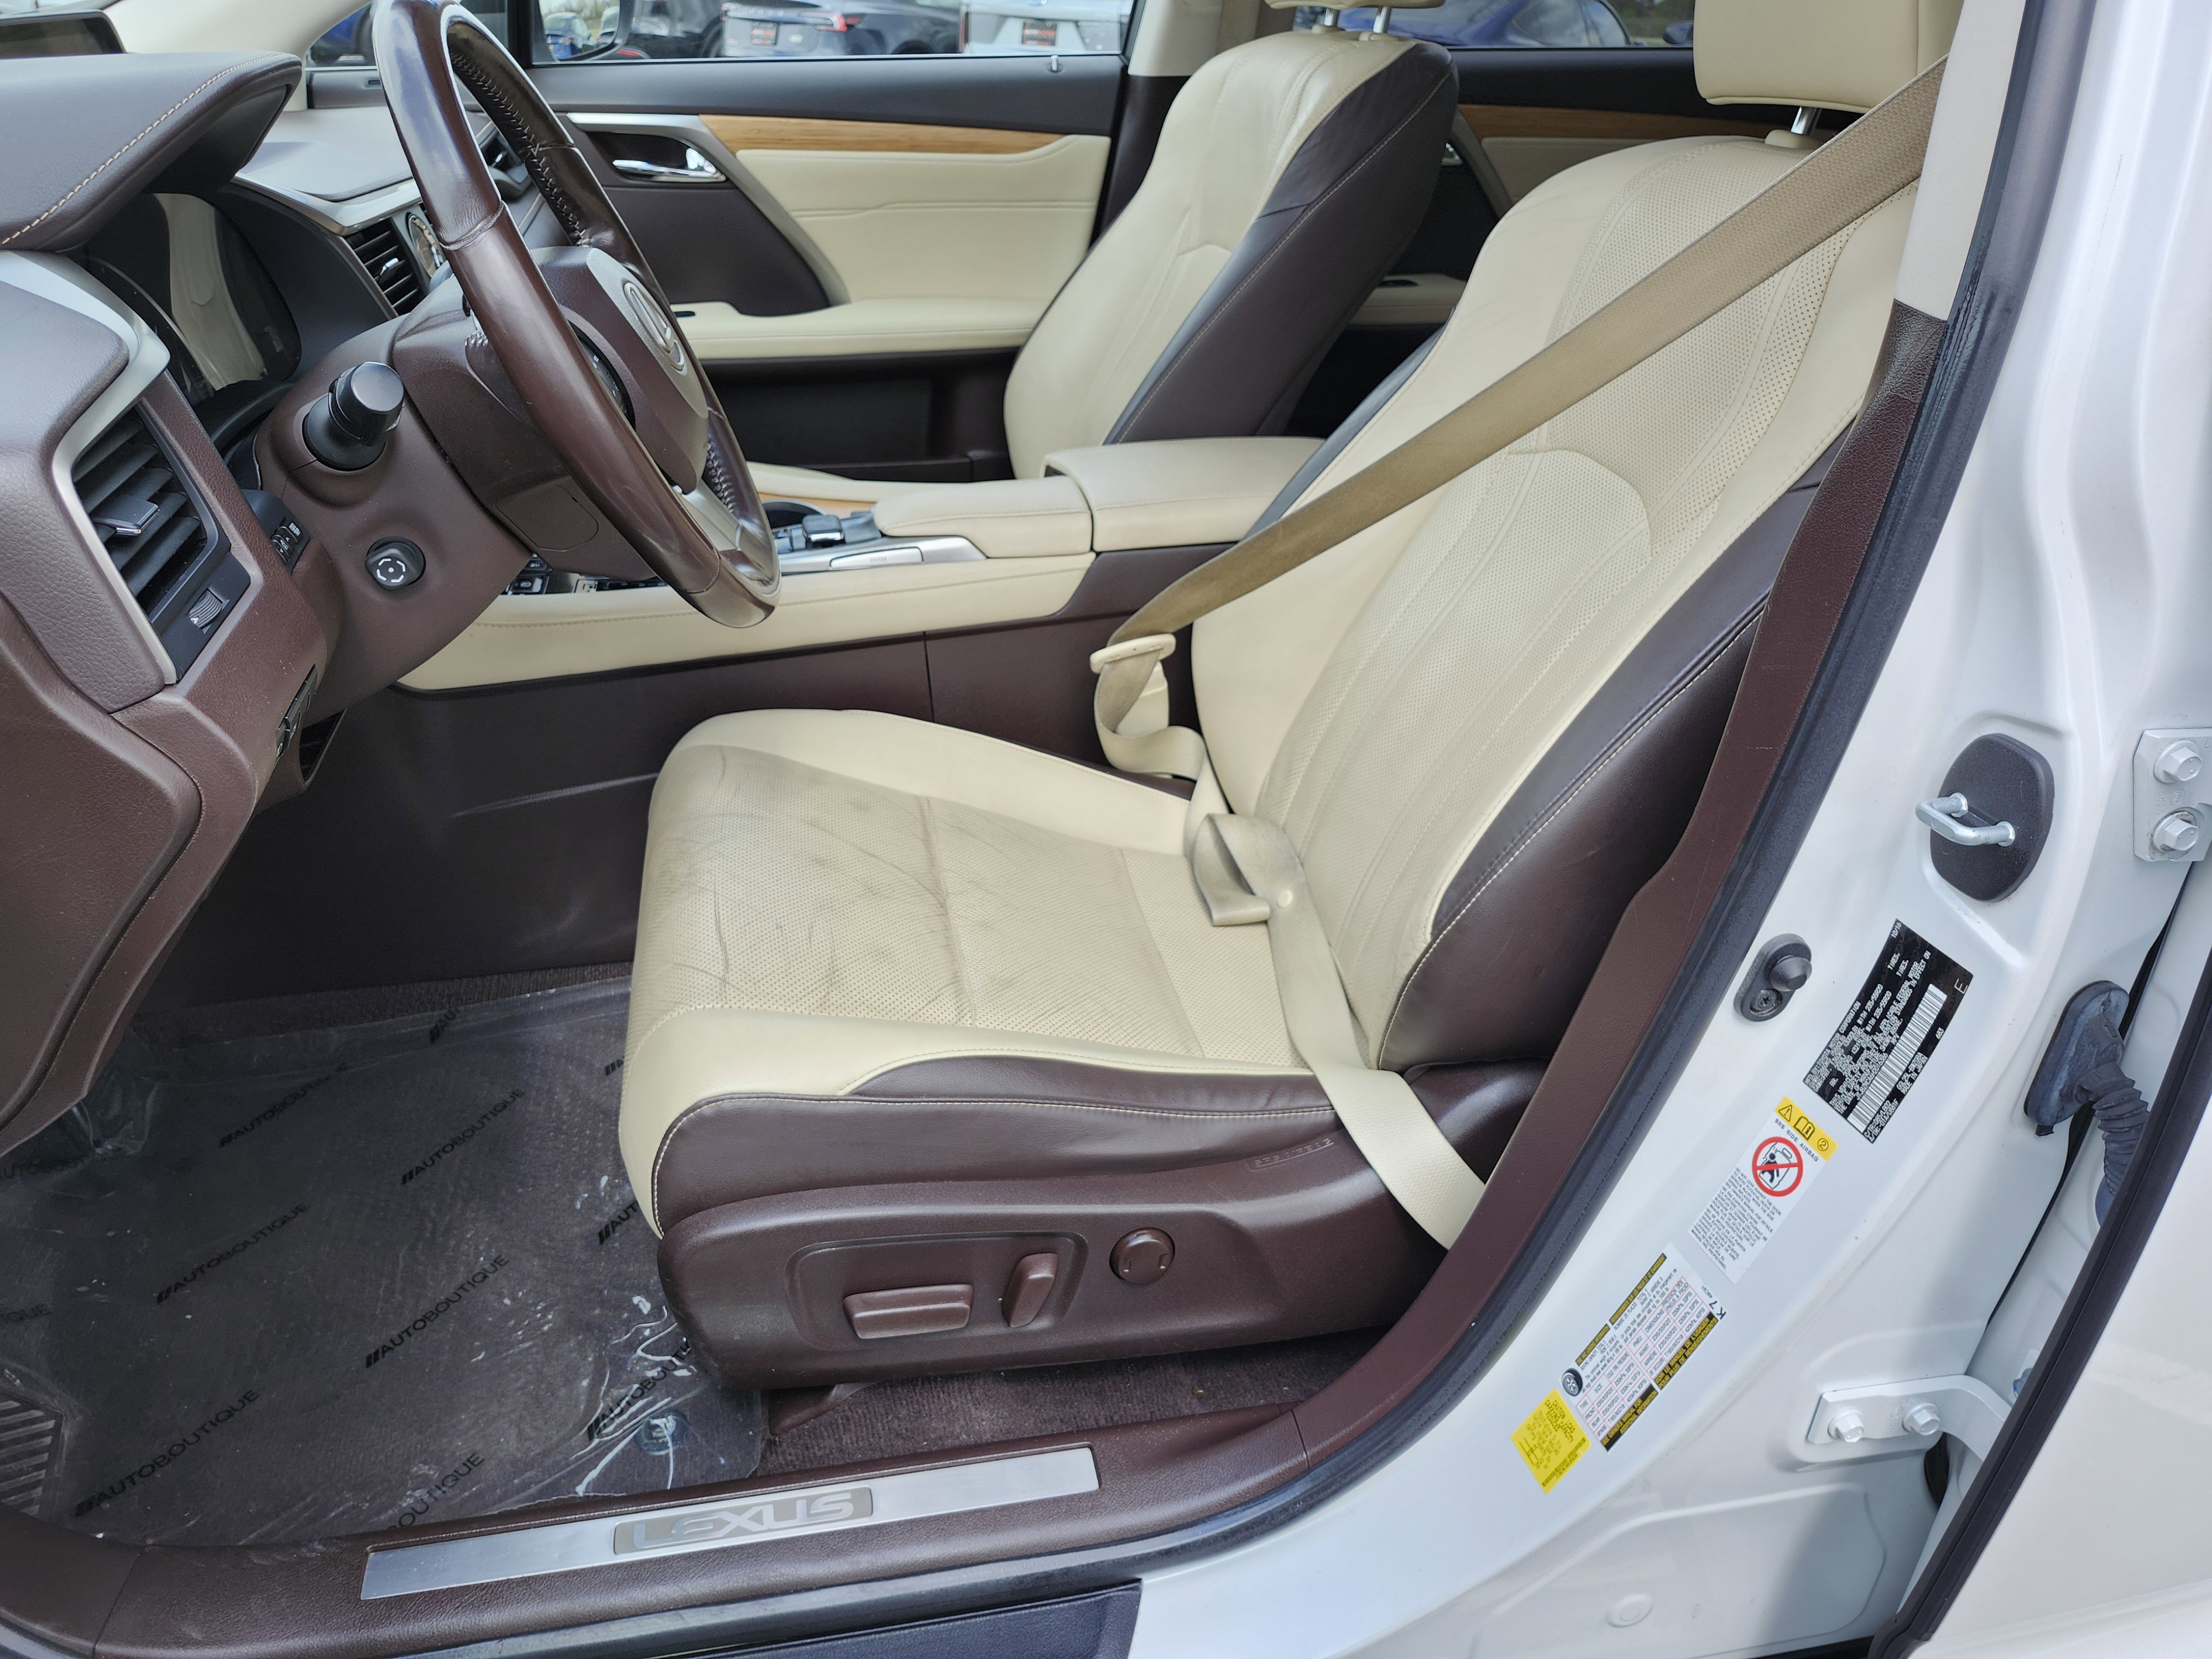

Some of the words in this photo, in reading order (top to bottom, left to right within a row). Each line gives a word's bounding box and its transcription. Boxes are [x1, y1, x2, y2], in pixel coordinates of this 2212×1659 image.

[1891, 921, 1902, 938] 10/16
[1923, 950, 1931, 959] ON
[1913, 958, 1927, 980] EFFECT
[1856, 1010, 1867, 1025] WITH
[1864, 983, 1884, 1012] 235/55R20
[1887, 951, 1900, 971] TIRES.
[1865, 1016, 1876, 1032] WITH
[1872, 989, 1892, 1019] 235/55R20
[1896, 958, 1909, 977] TIRES.
[1910, 978, 1917, 987] IN
[1894, 987, 1913, 1016] STANDARDS
[1828, 1031, 1841, 1050] MOTOR
[1838, 1000, 1861, 1034] CORPORATION
[1829, 1092, 1840, 1107] THIS
[1837, 1072, 1854, 1094] VEHICLE
[1851, 1047, 1870, 1074] CONFORMS
[1867, 1040, 1874, 1048] TO
[1872, 1031, 1880, 1041] ALL
[1878, 999, 1899, 1031] APPLICABLE
[1895, 979, 1911, 1001] FEDERAL
[1907, 960, 1919, 979] MOTOR
[1876, 1014, 1897, 1045] PREVENTION
[1838, 1103, 1848, 1114] THE
[1844, 1089, 1856, 1105] DATE
[1853, 1082, 1860, 1091] OF
[1859, 1050, 1882, 1084] MANUFACTURE
[1879, 1034, 1892, 1052] SHOWN
[1889, 1015, 1903, 1035] ABOVE.
[1866, 1044, 1879, 1061] THEFT
[1859, 1059, 1870, 1072] AND
[1900, 1079, 1912, 1094] MADE
[1910, 1070, 1918, 1080] IN
[1914, 1054, 1928, 1073] JAPAN
[1847, 1070, 1862, 1091] SAFETY
[1833, 1089, 1849, 1110] VEHICLE
[1774, 1118, 1785, 1130] SRS
[1786, 1129, 1799, 1142] SIDE
[1799, 1141, 1819, 1162] AIRBAG
[1737, 1176, 1746, 1186] AVOID
[1745, 1185, 1760, 1200] POTENTIAL
[1760, 1199, 1770, 1211] DEATH
[1751, 1197, 1760, 1207] WHEN
[1754, 1187, 1766, 1199] AGAINST
[1772, 1206, 1781, 1216] DOOR
[1743, 1201, 1755, 1213] MANUAL
[1708, 1298, 1718, 1310] 7
[1715, 1306, 1726, 1319] K
[1644, 1308, 1665, 1333] DIMENSIONS
[633, 1493, 855, 1550] LEXUS
